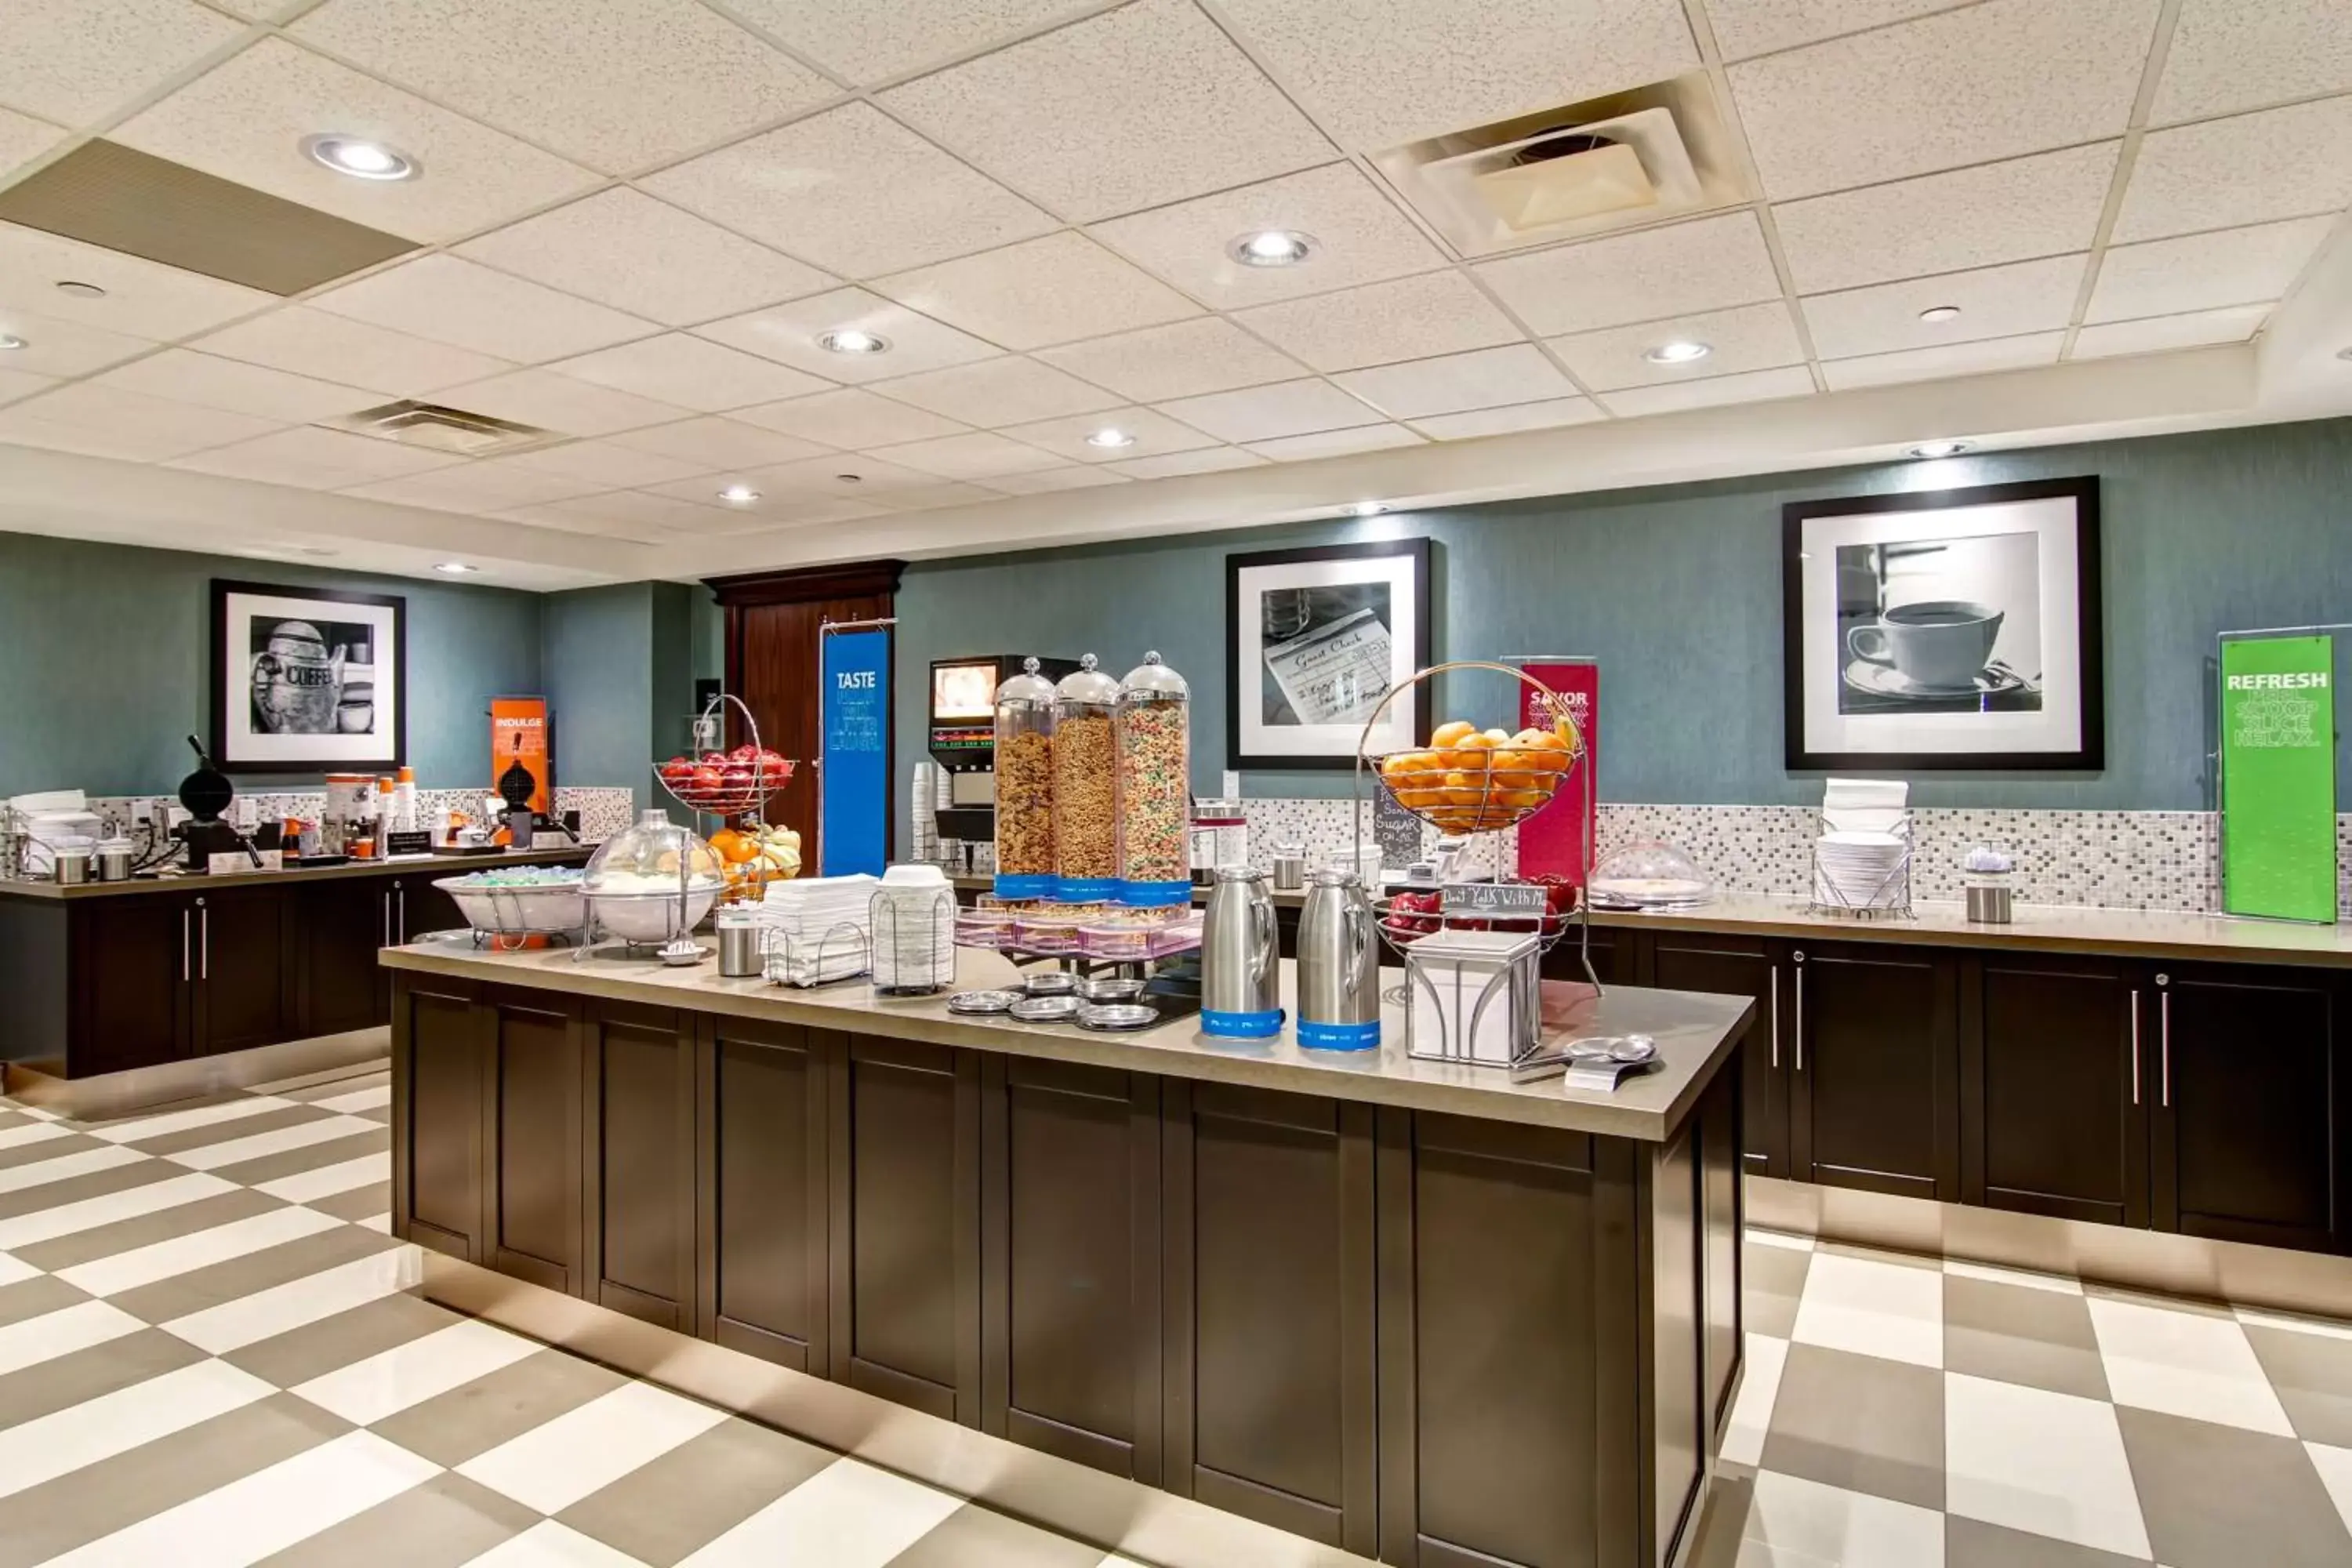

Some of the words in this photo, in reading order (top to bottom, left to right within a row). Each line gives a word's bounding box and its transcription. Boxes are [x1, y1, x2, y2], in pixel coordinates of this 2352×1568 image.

[837, 670, 876, 689] TASTE
[2227, 672, 2328, 691] REFRESH
[1530, 691, 1588, 706] SAVOR
[2235, 700, 2320, 719] SCOOP
[495, 718, 543, 728] INDULGE
[2242, 713, 2310, 734] SLICE
